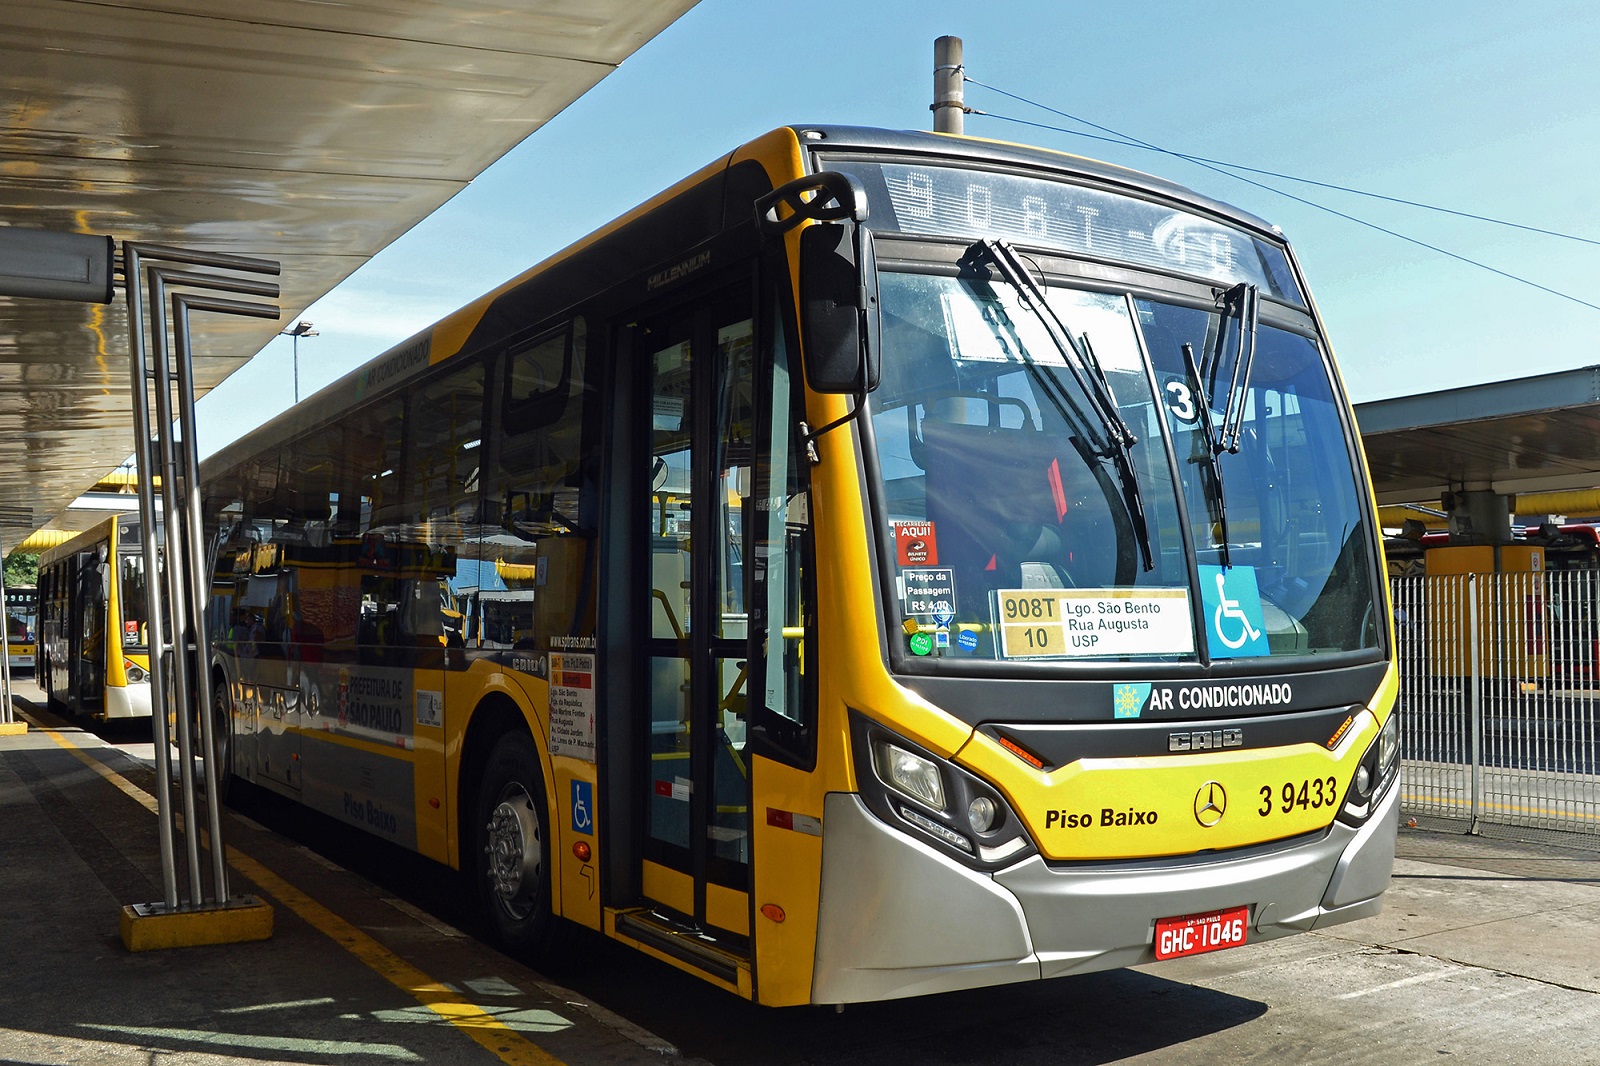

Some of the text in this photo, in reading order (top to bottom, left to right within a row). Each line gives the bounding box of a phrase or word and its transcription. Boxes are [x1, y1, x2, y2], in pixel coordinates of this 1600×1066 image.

[648, 250, 711, 291] MILLENNIUM
[901, 527, 931, 538] AQUI!
[910, 573, 947, 584] Preço da
[907, 586, 951, 597] Passagem
[912, 601, 926, 612] R$
[1005, 598, 1055, 619] 908T
[1066, 602, 1161, 617] Lgo. São Bento
[1069, 618, 1149, 632] Rua Augusta
[1024, 628, 1048, 648] 10
[1072, 635, 1099, 648] USP
[350, 676, 403, 700] PREFEITURA DE
[1149, 683, 1292, 711] AR CONDICIONADO
[350, 697, 369, 727] SÃO
[370, 704, 402, 733] PAULO
[1169, 728, 1243, 751] CAIO
[1258, 776, 1338, 817] 3 9433
[343, 792, 397, 834] Piso Baixo
[1045, 808, 1158, 829] Piso Baixo
